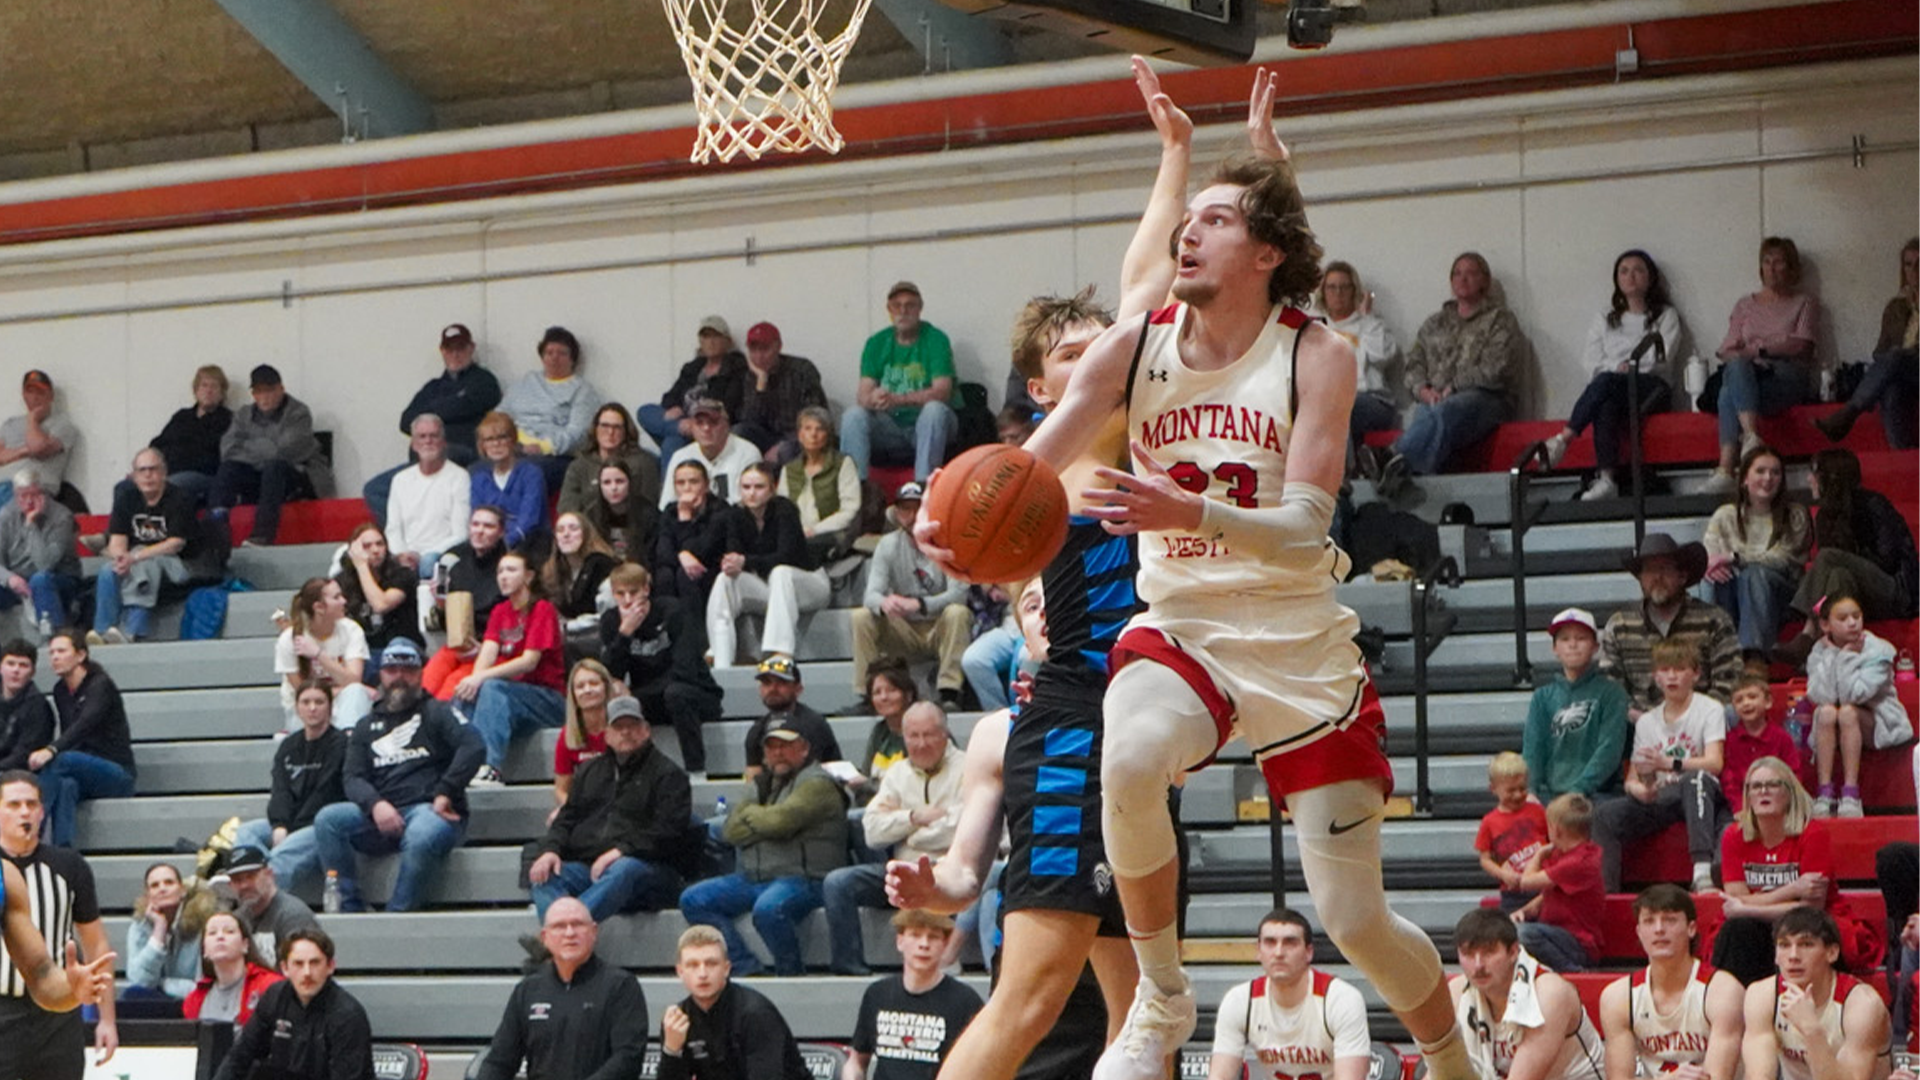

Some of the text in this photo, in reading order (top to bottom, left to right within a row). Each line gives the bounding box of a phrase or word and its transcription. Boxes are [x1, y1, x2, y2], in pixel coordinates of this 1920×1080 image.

[1142, 404, 1283, 454] MONTANA
[373, 746, 430, 768] HONDA
[877, 1010, 946, 1028] MONTANA
[877, 1024, 946, 1041] WESTERN
